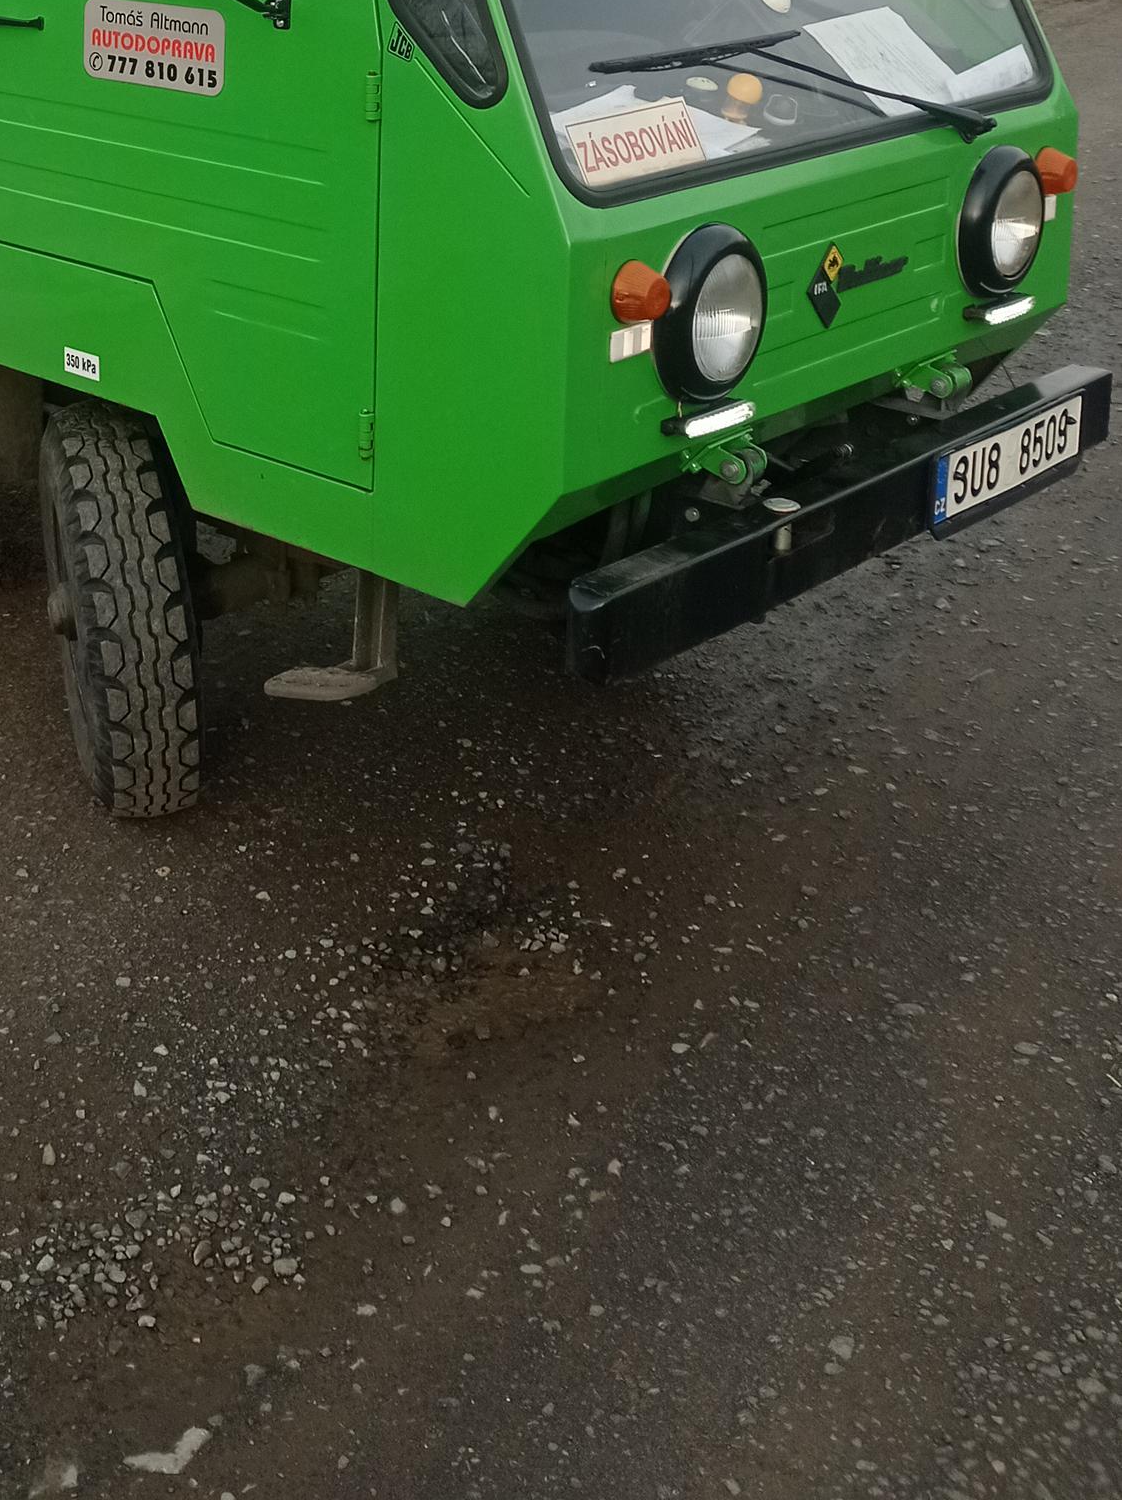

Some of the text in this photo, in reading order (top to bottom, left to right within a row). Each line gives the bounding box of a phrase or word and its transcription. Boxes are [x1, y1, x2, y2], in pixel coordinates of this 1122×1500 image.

[100, 5, 209, 36] Tomáš Altmann
[91, 28, 216, 64] AUTODOPRAVA
[389, 28, 413, 60] JCB
[107, 54, 218, 88] 777 810 615
[576, 110, 698, 173] ZÁSOBOVÁNÍ
[813, 281, 828, 296] IFA
[66, 352, 96, 374] 350 kPa
[953, 408, 1070, 505] 3U8 8509
[934, 498, 946, 516] CZ
